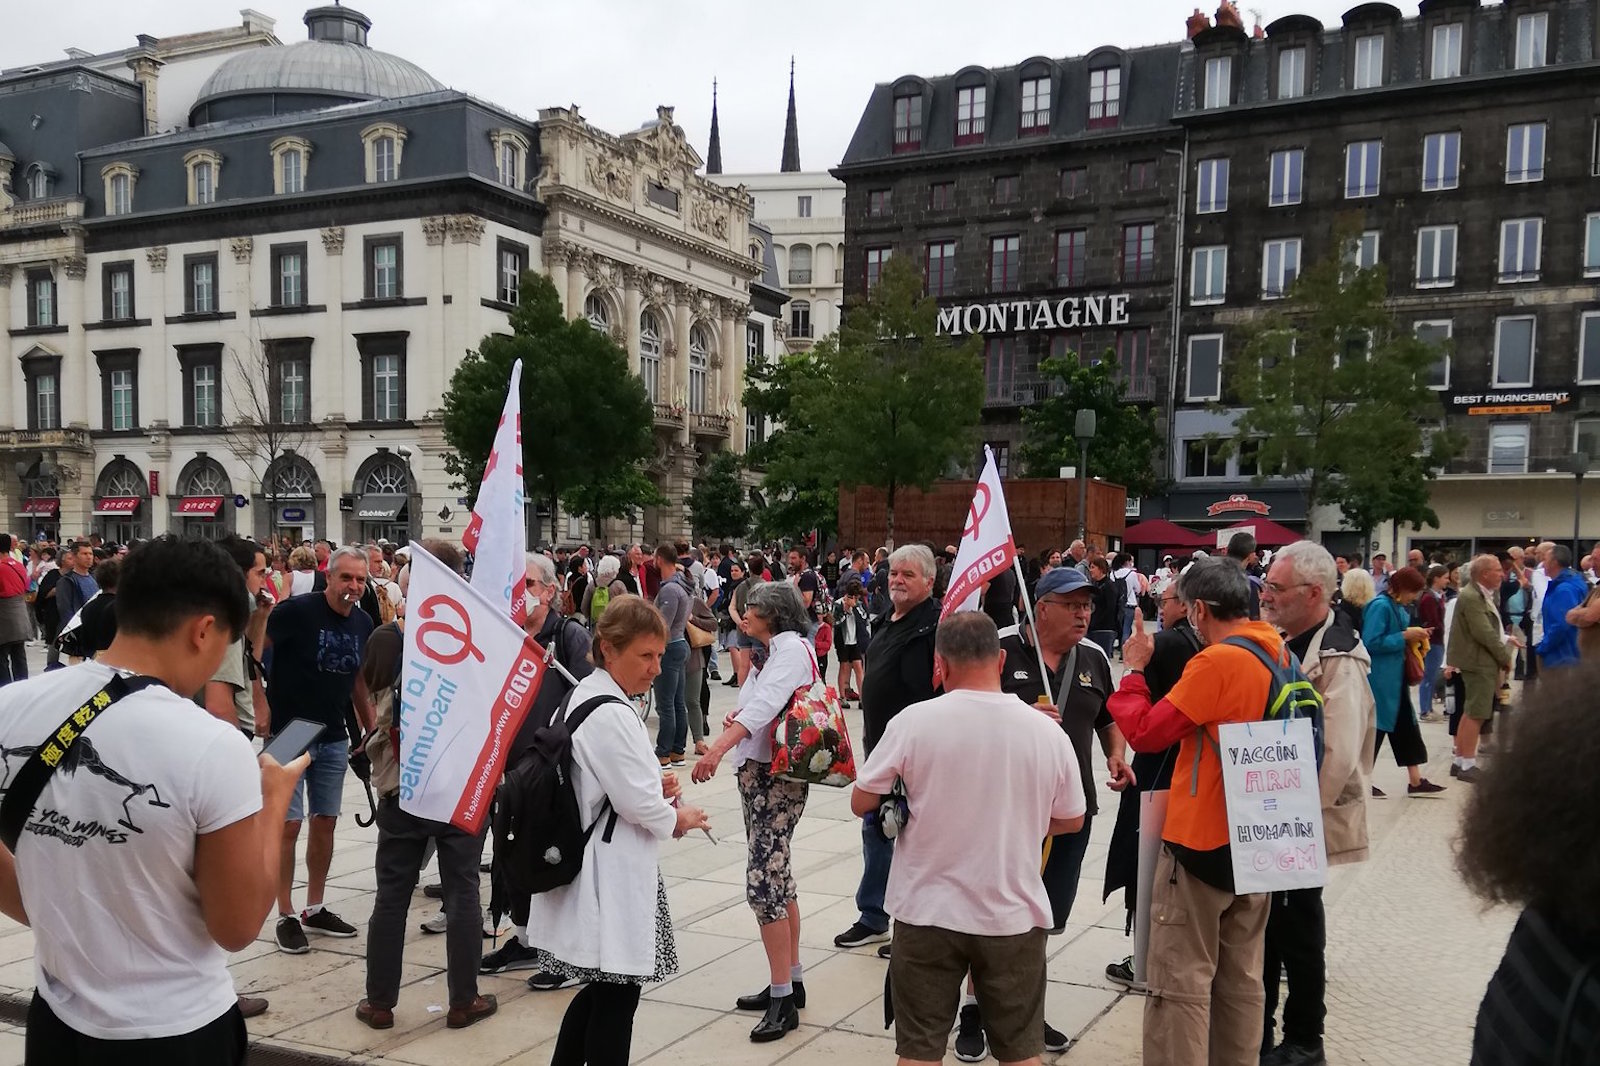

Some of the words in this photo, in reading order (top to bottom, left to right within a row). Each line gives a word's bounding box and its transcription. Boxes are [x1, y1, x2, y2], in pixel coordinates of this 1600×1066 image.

[935, 293, 1130, 336] MONTAGNE
[1453, 395, 1483, 405] BEST
[1485, 392, 1569, 404] FINANCEMENT
[1246, 768, 1302, 793] ARN
[71, 820, 130, 845] WINGS
[1252, 844, 1319, 872] OGM
